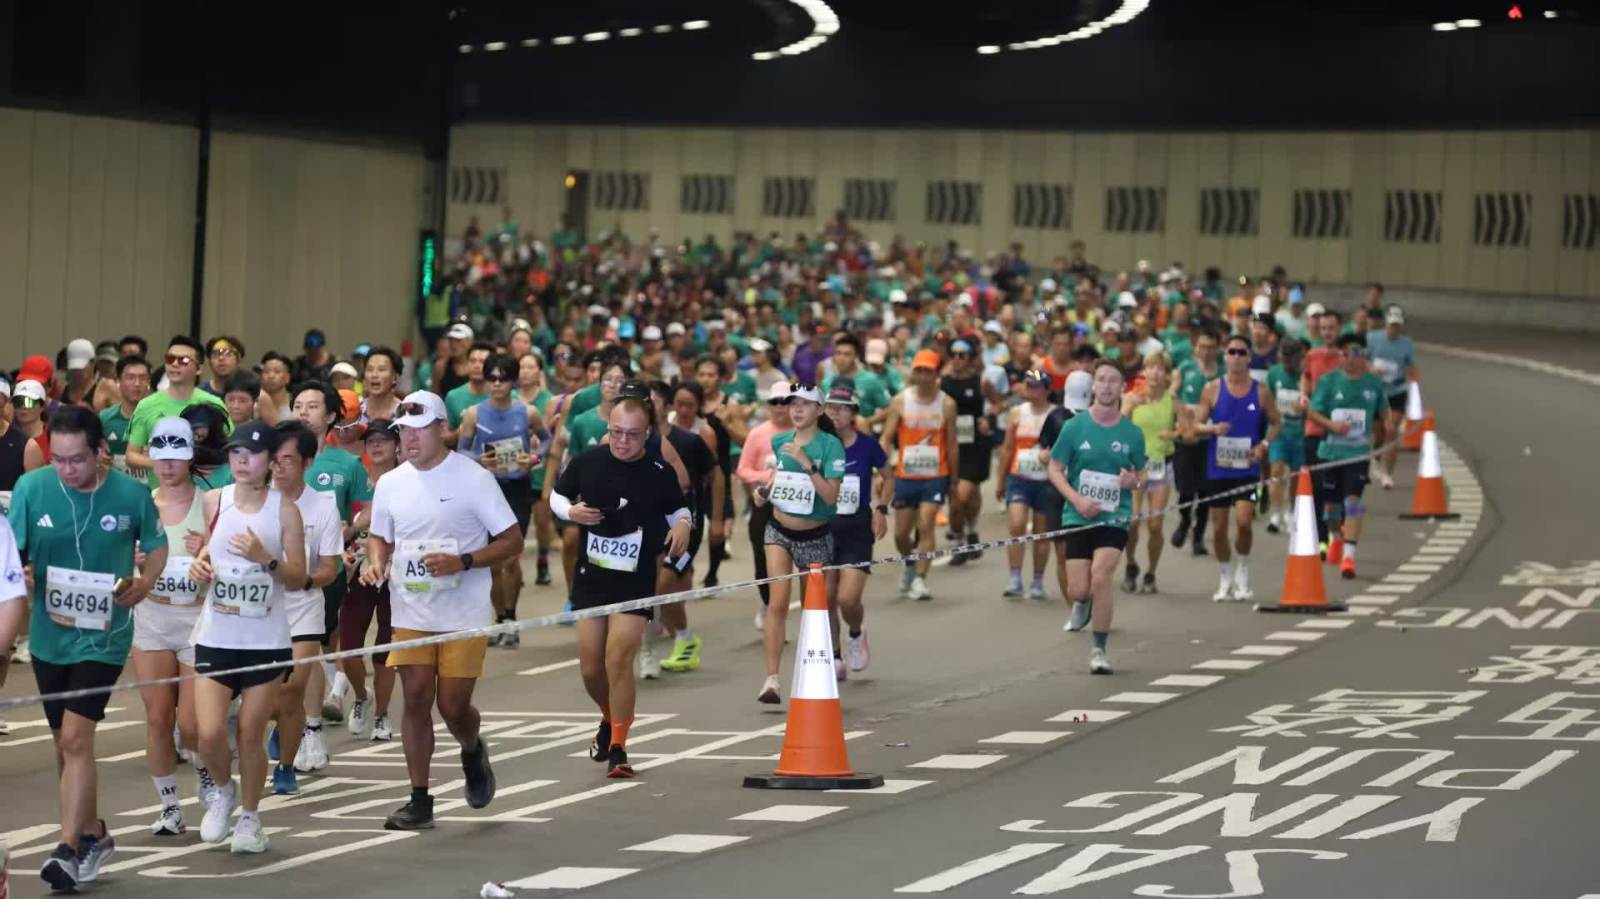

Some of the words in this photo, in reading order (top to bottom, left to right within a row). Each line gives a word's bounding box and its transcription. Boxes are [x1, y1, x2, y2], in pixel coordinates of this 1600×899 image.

[772, 486, 812, 503] E5244
[1080, 484, 1119, 502] G6895
[590, 537, 638, 558] A6292
[406, 559, 427, 577] A5
[153, 577, 197, 592] 5840
[214, 580, 269, 602] G0127
[49, 589, 109, 613] G4694
[1155, 745, 1579, 790] PUN
[999, 792, 1486, 841] YING
[893, 843, 1348, 898] SAI
